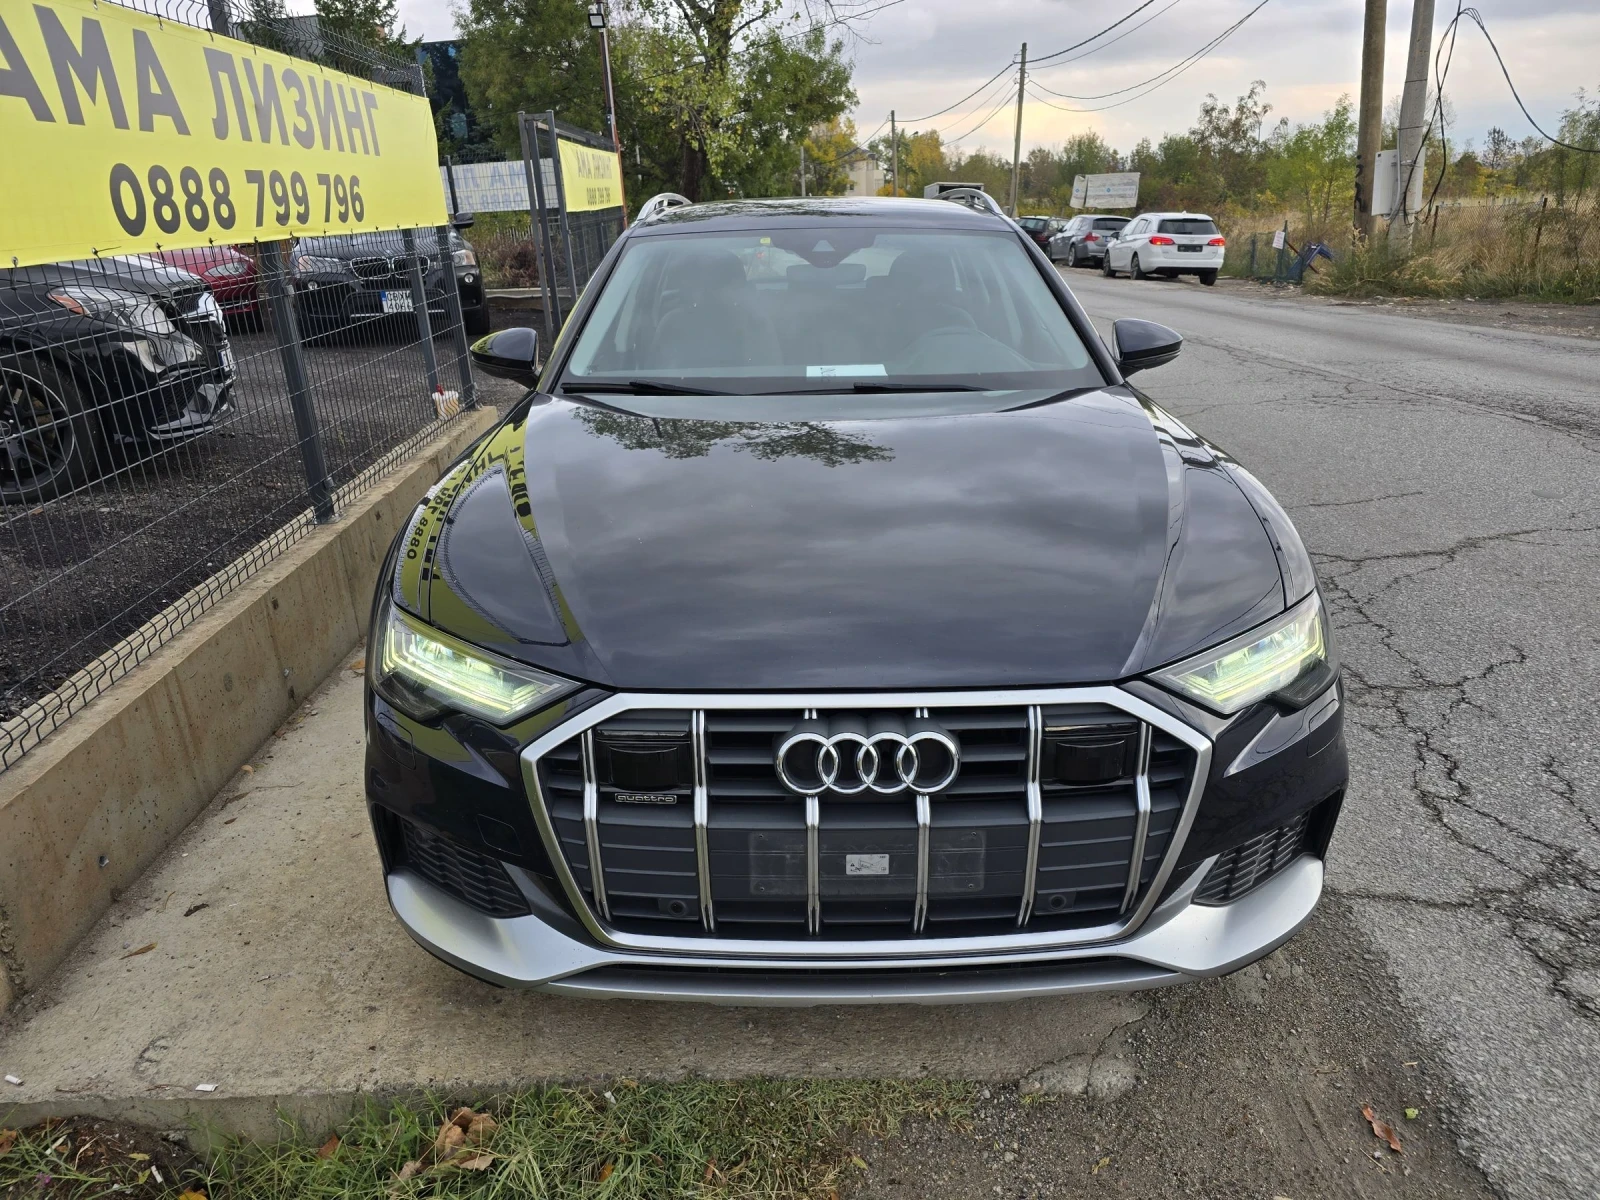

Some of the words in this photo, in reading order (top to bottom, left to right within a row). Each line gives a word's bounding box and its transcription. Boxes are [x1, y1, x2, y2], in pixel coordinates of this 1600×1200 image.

[203, 46, 381, 157] ЛИЗИНГ
[109, 162, 236, 237] 0888
[245, 169, 310, 227] 799
[316, 173, 365, 223] 796
[617, 795, 674, 803] quattro
